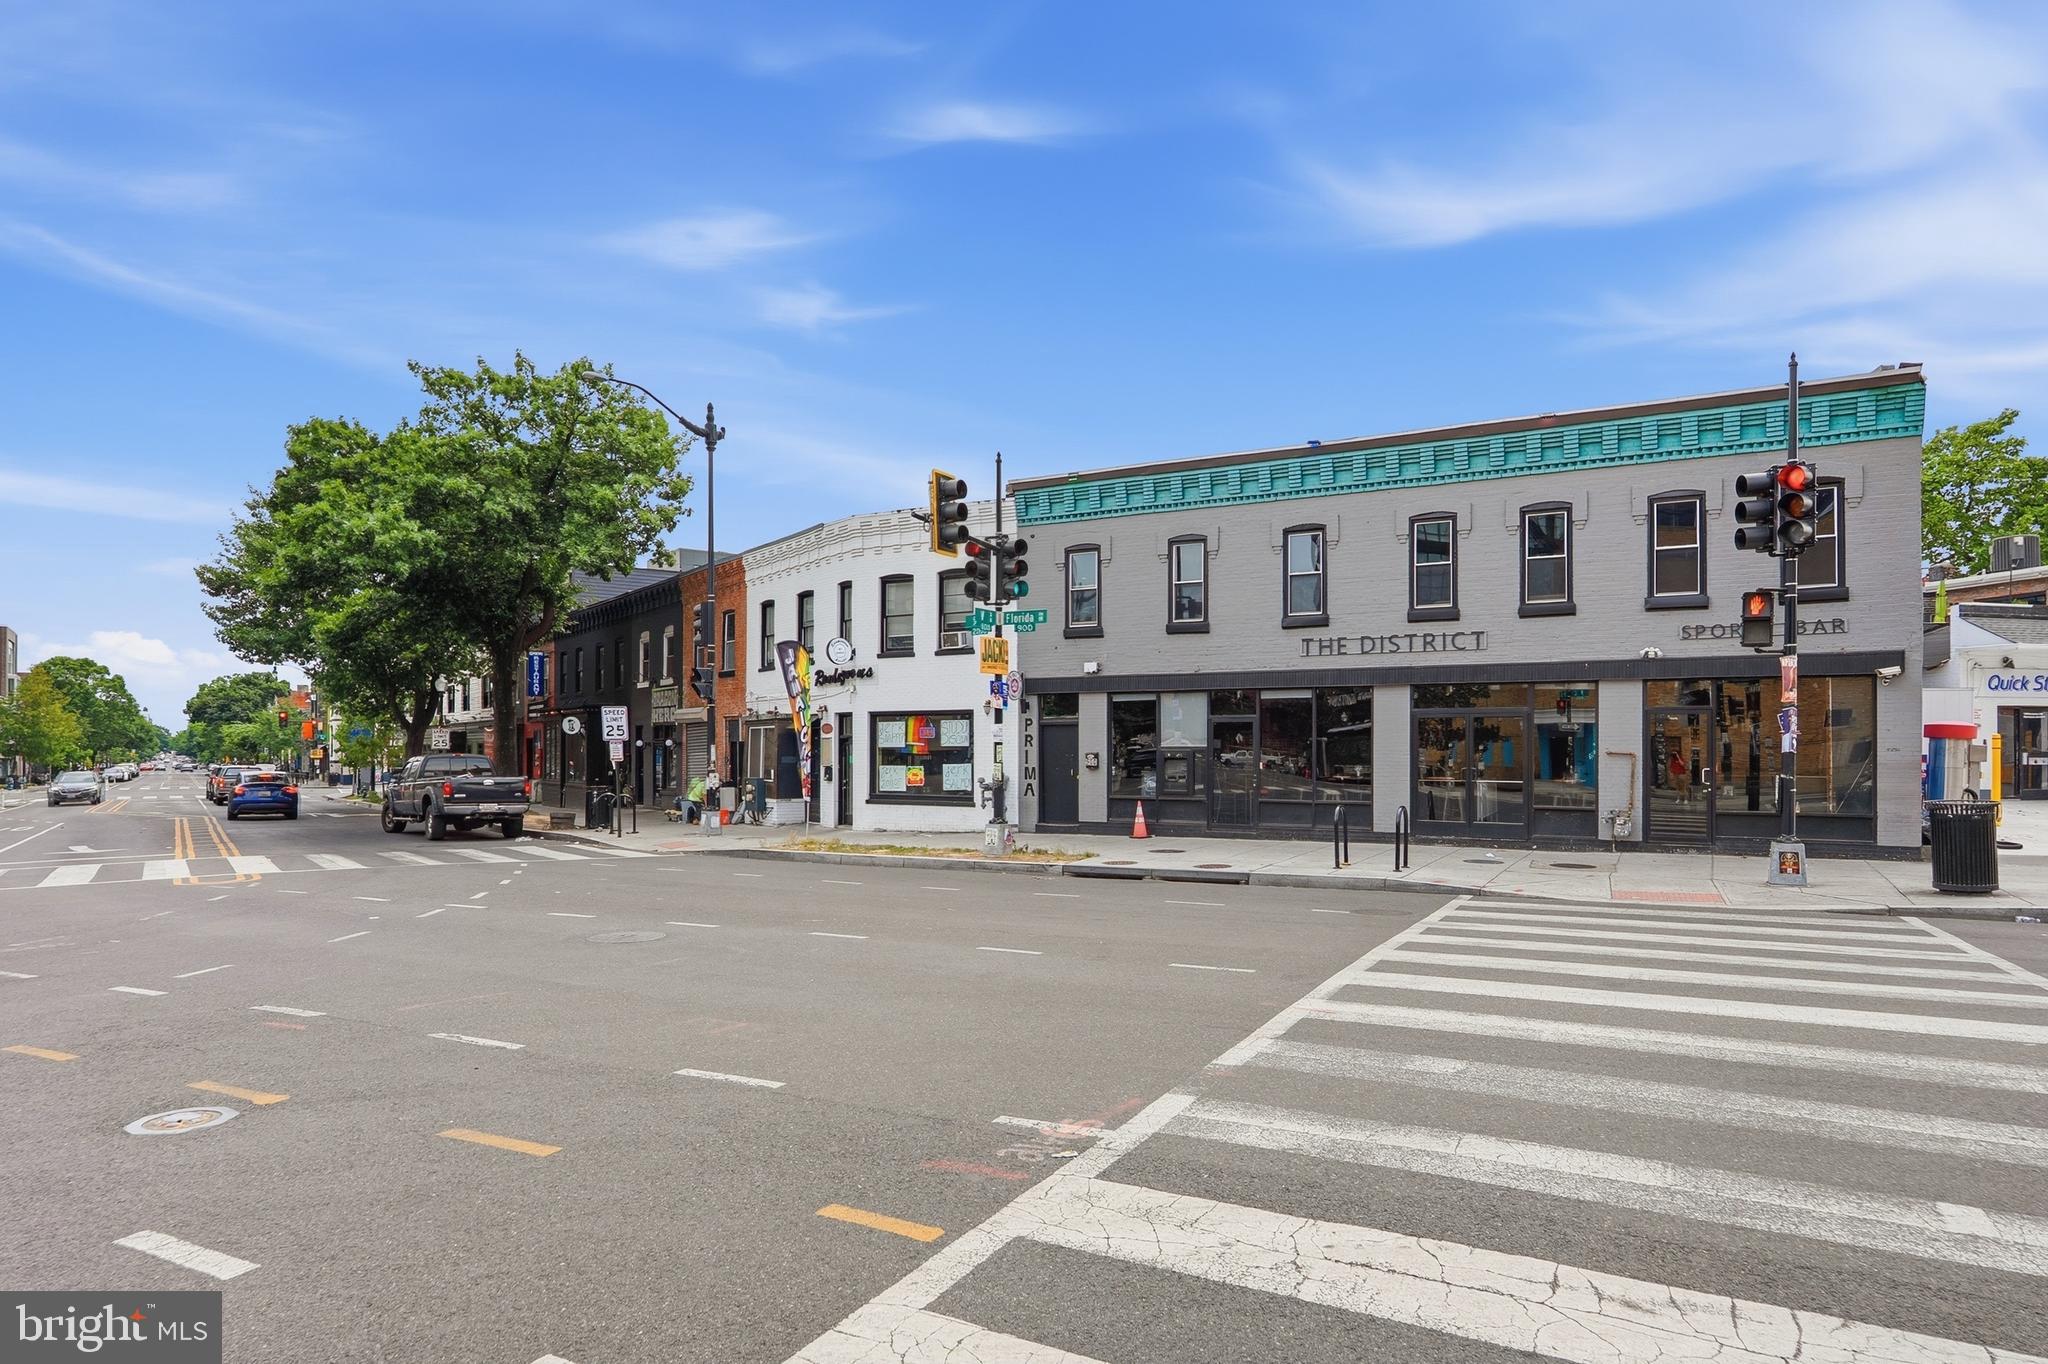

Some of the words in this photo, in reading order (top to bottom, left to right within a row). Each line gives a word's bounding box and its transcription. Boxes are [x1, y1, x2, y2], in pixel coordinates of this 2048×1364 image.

[1005, 611, 1034, 623] Florida
[1016, 624, 1034, 632] 900
[1681, 623, 1743, 640] SPOR
[1796, 618, 1846, 636] BAR
[1302, 637, 1347, 656] THE
[1360, 631, 1485, 655] DISTRICT
[1987, 674, 2030, 691] Quick
[605, 724, 625, 737] 25
[433, 739, 448, 747] 25
[1023, 717, 1036, 797] PRIMA
